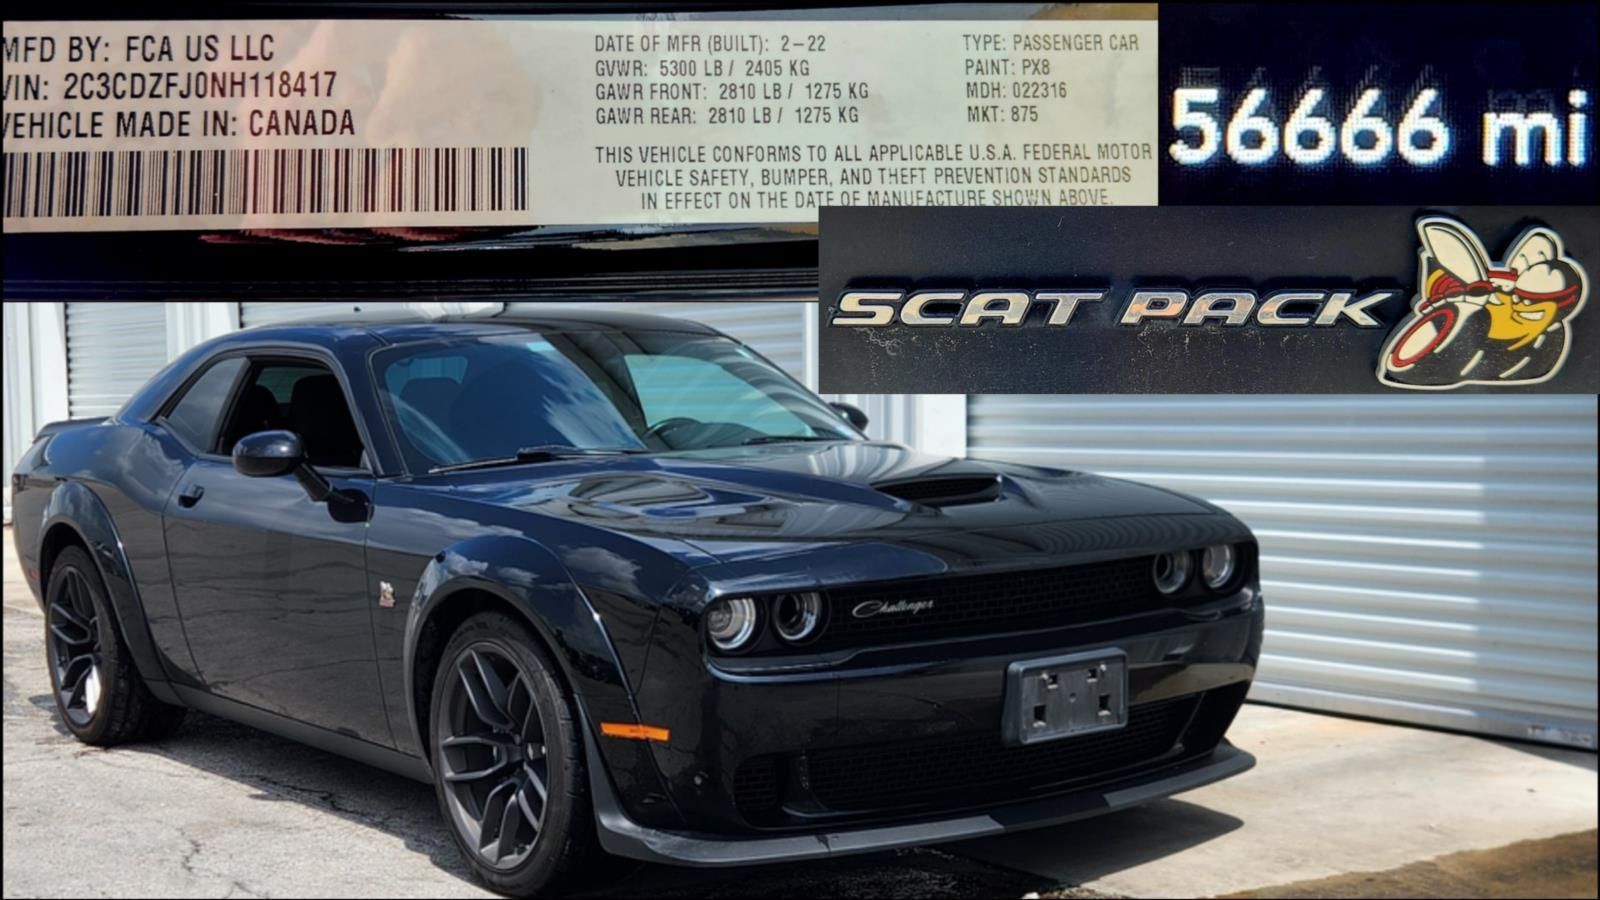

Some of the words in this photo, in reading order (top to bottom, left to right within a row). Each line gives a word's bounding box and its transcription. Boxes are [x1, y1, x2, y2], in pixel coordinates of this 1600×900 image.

[4, 37, 55, 62] MFD
[69, 36, 109, 62] BY:
[126, 35, 173, 62] FCA
[186, 35, 218, 62] US
[231, 34, 273, 61] LLC
[595, 35, 635, 51] DATE
[641, 35, 660, 52] OF
[668, 35, 701, 52] MFR
[708, 35, 768, 55] (BUILT):
[963, 34, 1005, 51] TYPE:
[1013, 34, 1103, 51] PASSENGER
[1110, 34, 1139, 50] CAR
[596, 60, 647, 77] GVWR:
[660, 60, 696, 76] 5300
[746, 60, 782, 76] 2405
[790, 60, 809, 76] KG
[966, 59, 1014, 75] PAINT:
[1022, 59, 1050, 75] PX8
[64, 71, 336, 100] 2C3CDZFJ0NH118417
[596, 83, 643, 100] GAWR
[650, 83, 706, 100] FRONT:
[720, 83, 755, 100] 2810
[806, 83, 841, 99] 1275
[849, 83, 868, 99] KG
[967, 82, 1006, 98] MDH:
[1013, 82, 1066, 98] 022316
[116, 111, 190, 137] MADE
[203, 111, 236, 136] IN:
[250, 109, 355, 136] CANADA
[596, 107, 643, 124] GAWR
[651, 107, 696, 124] REAR:
[709, 107, 745, 124] 2810
[795, 107, 831, 123] 1275
[839, 106, 858, 123] KG
[968, 106, 1004, 122] MKT:
[1011, 105, 1038, 122] 875
[1170, 87, 1449, 167] 56666
[1483, 88, 1588, 167] mi
[595, 146, 632, 163] THIS
[639, 146, 705, 163] VEHICLE
[713, 145, 801, 162] CONFORMS
[807, 145, 826, 162] TO
[835, 145, 862, 161] ALL
[869, 144, 962, 161] APPLICABLE
[970, 144, 1016, 160] U.S.A.
[1024, 144, 1091, 160] FEDERAL
[1098, 143, 1152, 159] MOTOR
[616, 169, 682, 187] VEHICLE
[690, 169, 753, 187] SAFETY,
[762, 168, 832, 186] BUMPER,
[840, 168, 872, 184] AND
[878, 168, 926, 184] THEFT
[935, 167, 1031, 184] PREVENTION
[1038, 166, 1131, 183] STANDARDS
[642, 193, 656, 209] IN
[666, 192, 721, 209] EFFECT
[729, 192, 750, 208] ON
[757, 191, 787, 208] THE
[795, 191, 834, 209] DATE
[840, 191, 860, 206] OF
[867, 190, 986, 206] MANUFACTURE
[992, 190, 1052, 206] SHOWN
[1059, 188, 1112, 206] ABOVE.
[833, 292, 1104, 327] SCAT
[1120, 291, 1393, 327] PACK
[852, 600, 934, 618] Challenger
